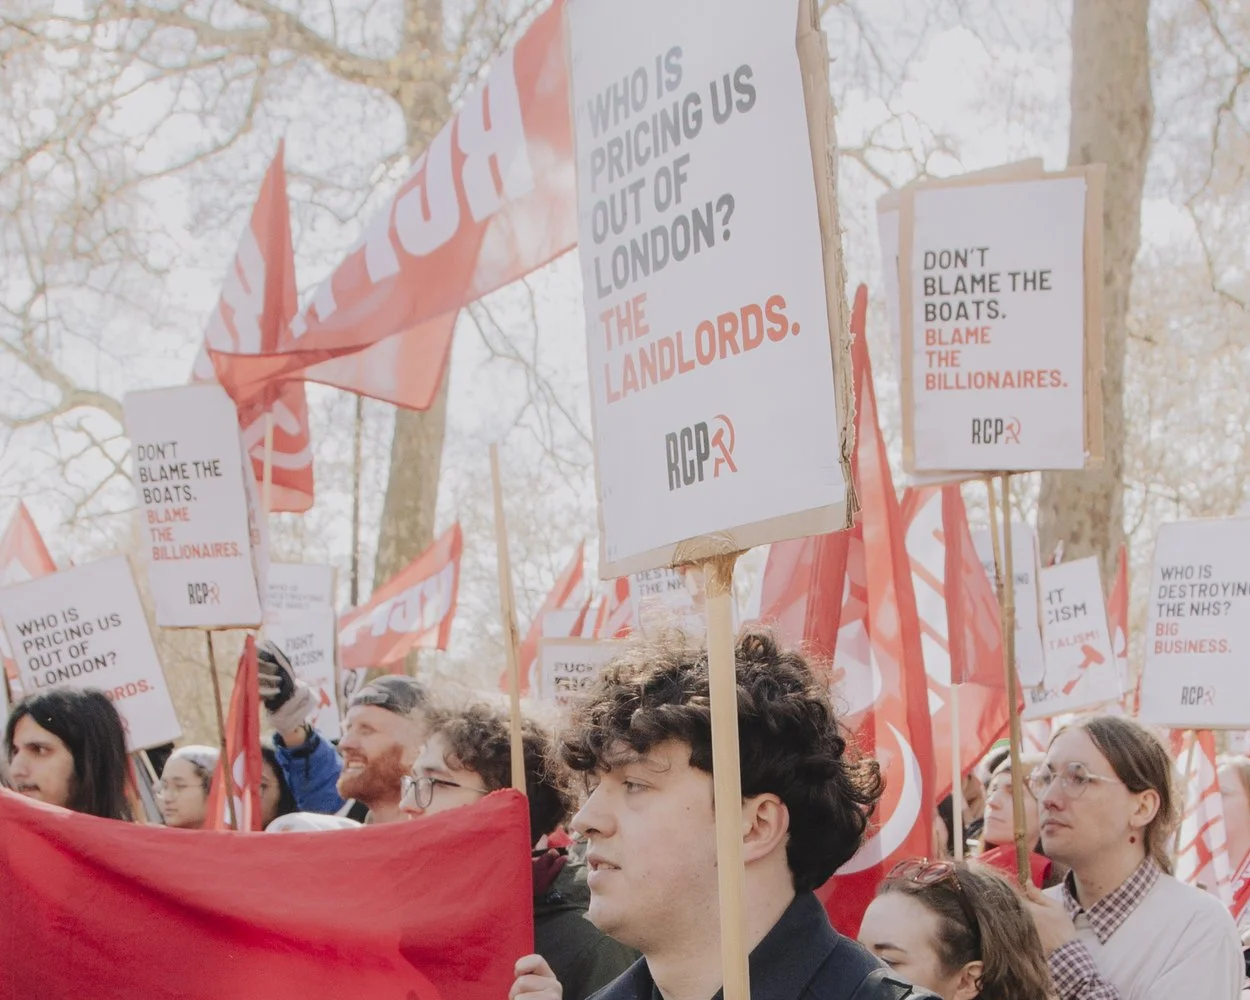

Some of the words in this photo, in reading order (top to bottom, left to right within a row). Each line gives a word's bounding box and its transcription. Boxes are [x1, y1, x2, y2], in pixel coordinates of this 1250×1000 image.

[588, 66, 648, 139] WHO
[655, 46, 683, 100] IS
[590, 92, 703, 194] PRICING
[709, 64, 757, 125] US
[591, 177, 646, 245] OUT
[653, 153, 690, 213] OF
[594, 193, 735, 300] LONDON?
[923, 247, 990, 270] DON'T
[924, 273, 1001, 297] BLAME
[1008, 270, 1053, 292] THE
[600, 292, 650, 351] THE
[924, 300, 1007, 322] BOATS.
[925, 326, 991, 346] BLAME
[604, 294, 801, 404] LANDLORDS.
[925, 350, 961, 368] THE
[925, 369, 1068, 391] BILLIONAIRES.
[971, 418, 1004, 445] RCP
[137, 442, 178, 462] DON'T
[665, 421, 711, 491] RCP
[139, 463, 190, 483] BLAME
[194, 460, 223, 478] THE
[143, 486, 198, 505] BOATS.
[147, 507, 191, 524] BLAME
[151, 527, 174, 543] THE
[152, 542, 243, 561] BILLIONAIRES.
[1160, 565, 1194, 581] WHO
[1198, 564, 1213, 579] IS
[188, 583, 209, 605] RCP
[1156, 602, 1186, 618] THE
[1189, 601, 1232, 617] NHS?
[16, 613, 58, 637] WHO
[62, 607, 80, 624] IS
[1155, 622, 1179, 637] BIG
[22, 621, 94, 655] PRICING
[97, 613, 122, 632] US
[28, 650, 63, 672] OUT
[68, 640, 90, 660] OF
[1154, 639, 1232, 655] BUSINESS.
[32, 651, 117, 689] LONDON?
[1181, 685, 1204, 705] RCP
